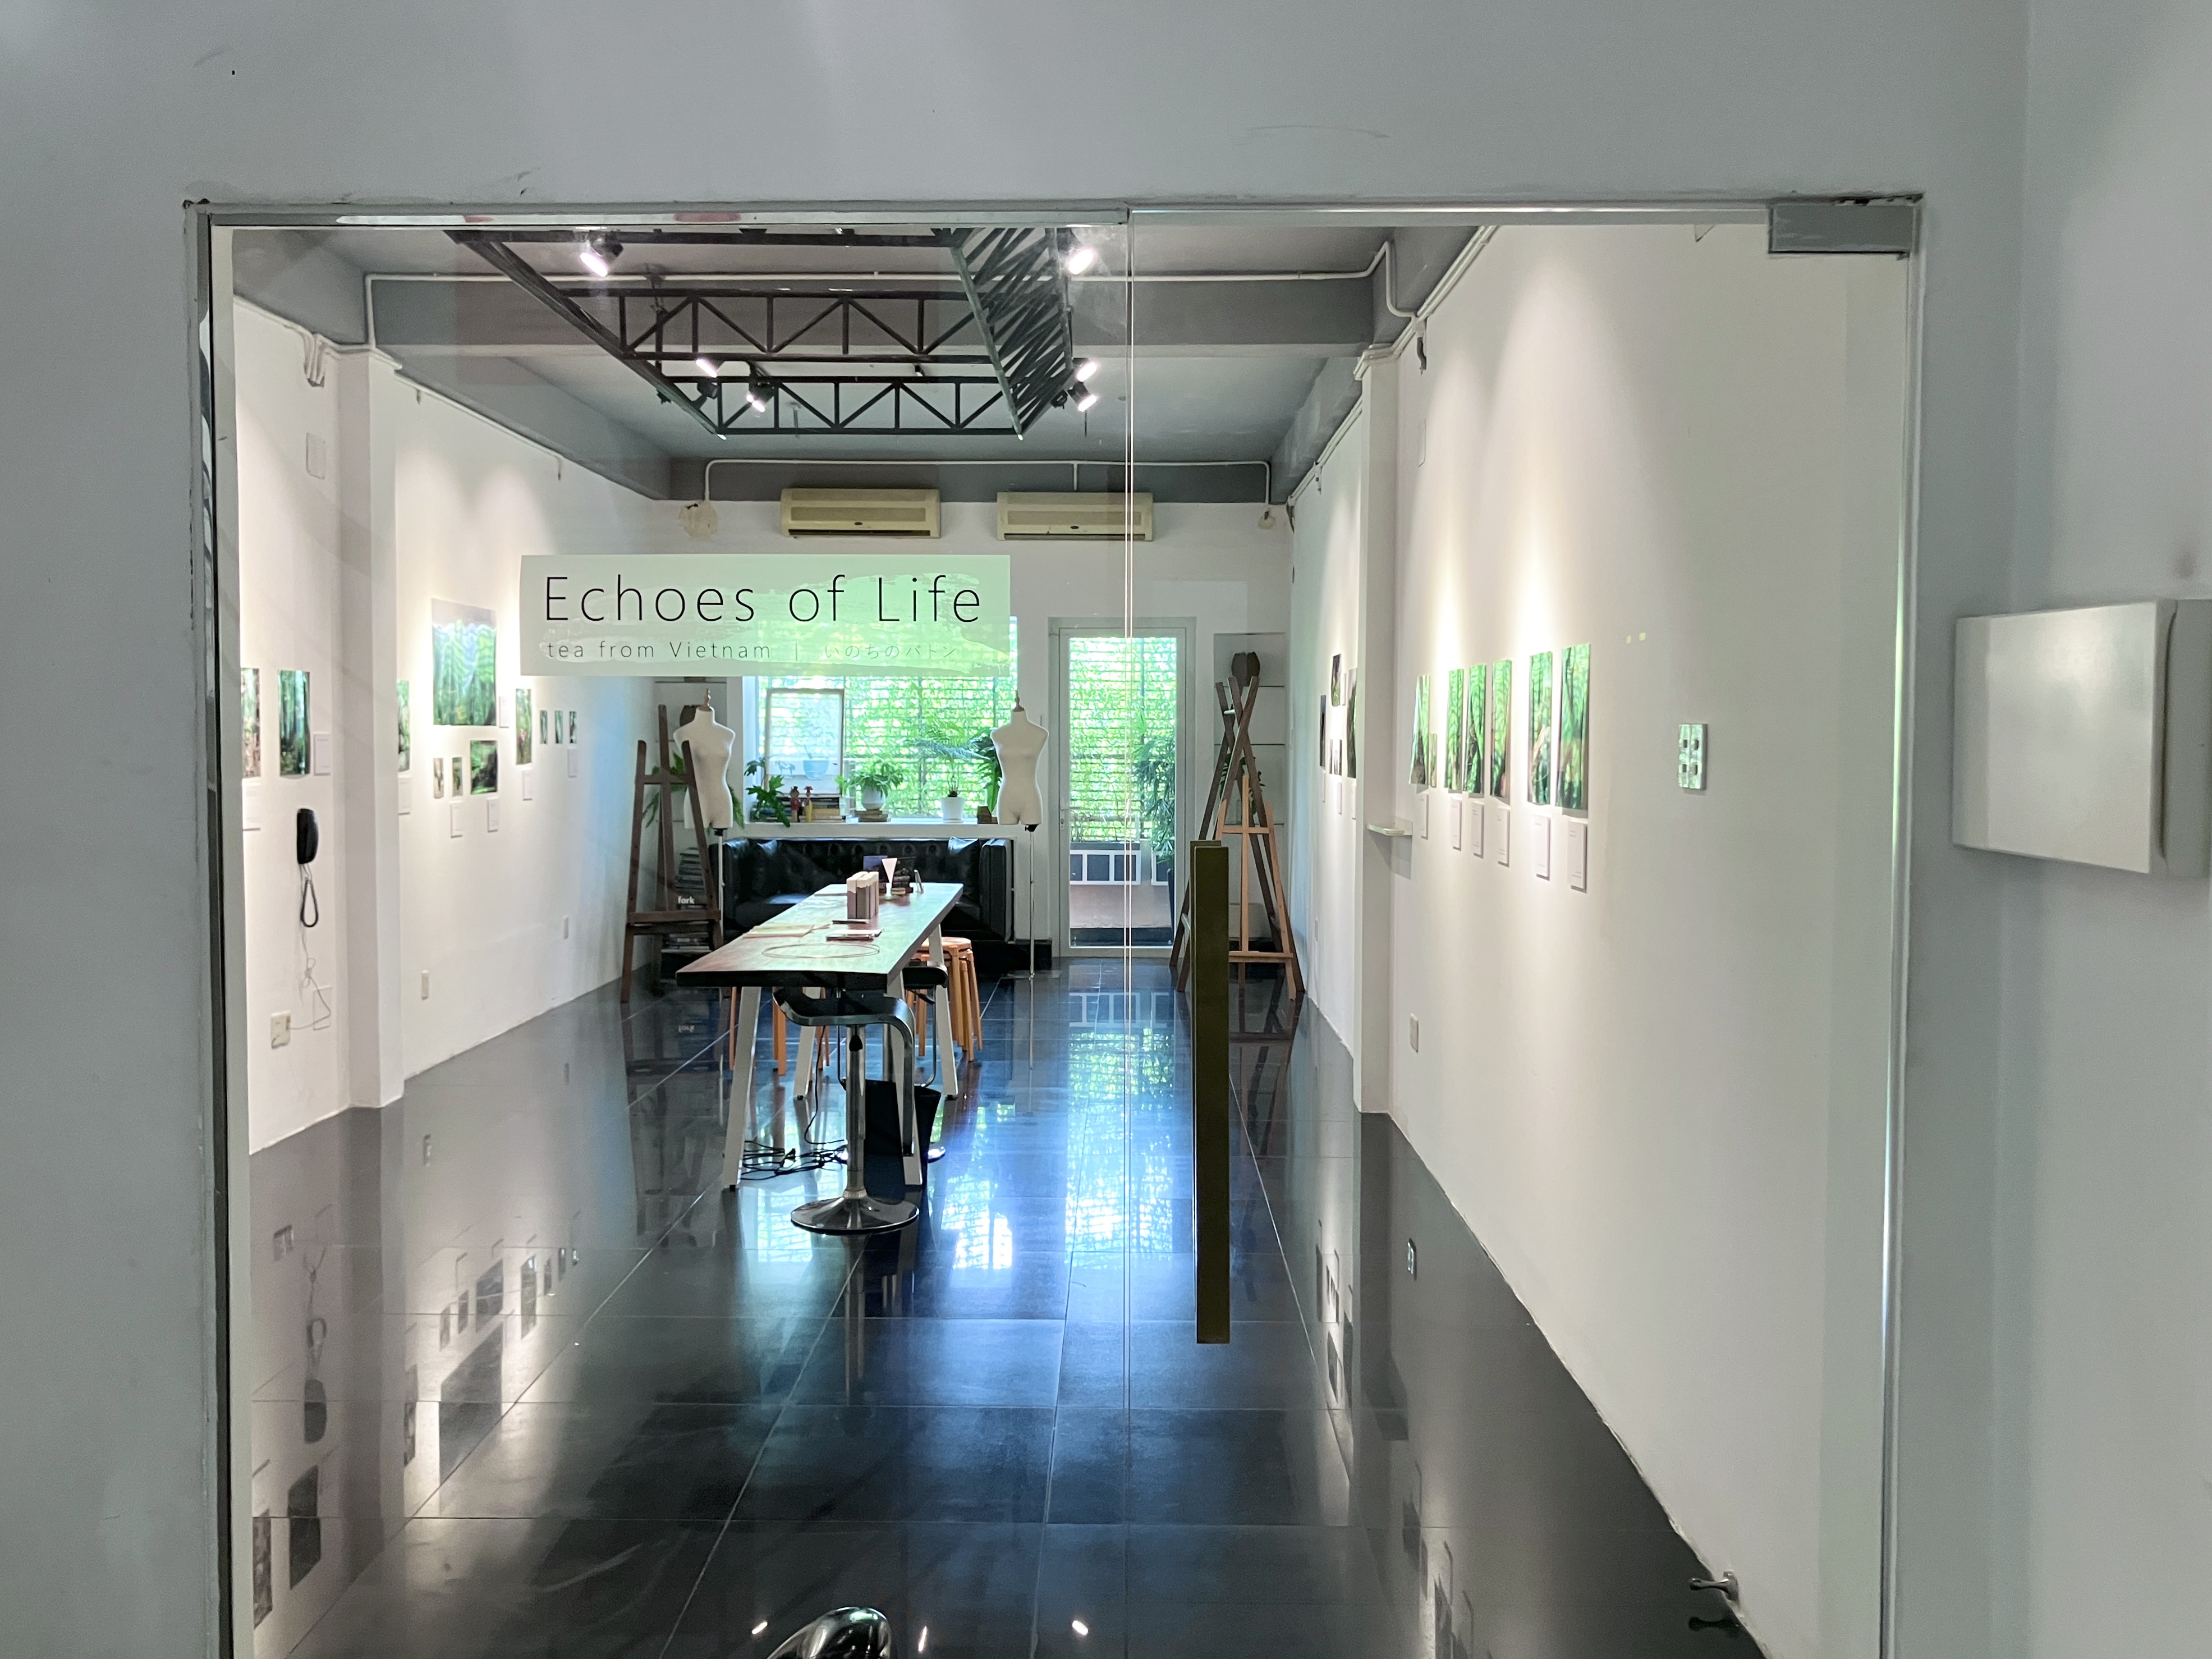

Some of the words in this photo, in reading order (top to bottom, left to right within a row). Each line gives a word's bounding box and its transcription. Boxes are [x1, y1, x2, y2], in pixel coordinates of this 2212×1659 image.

[546, 574, 755, 622] Echoes
[788, 574, 846, 622] of
[878, 574, 980, 622] Life
[547, 642, 584, 658] tea
[599, 640, 654, 658] from
[669, 641, 770, 659] Vietnam
[824, 644, 956, 660] いのちのバトン
[678, 896, 695, 904] fork
